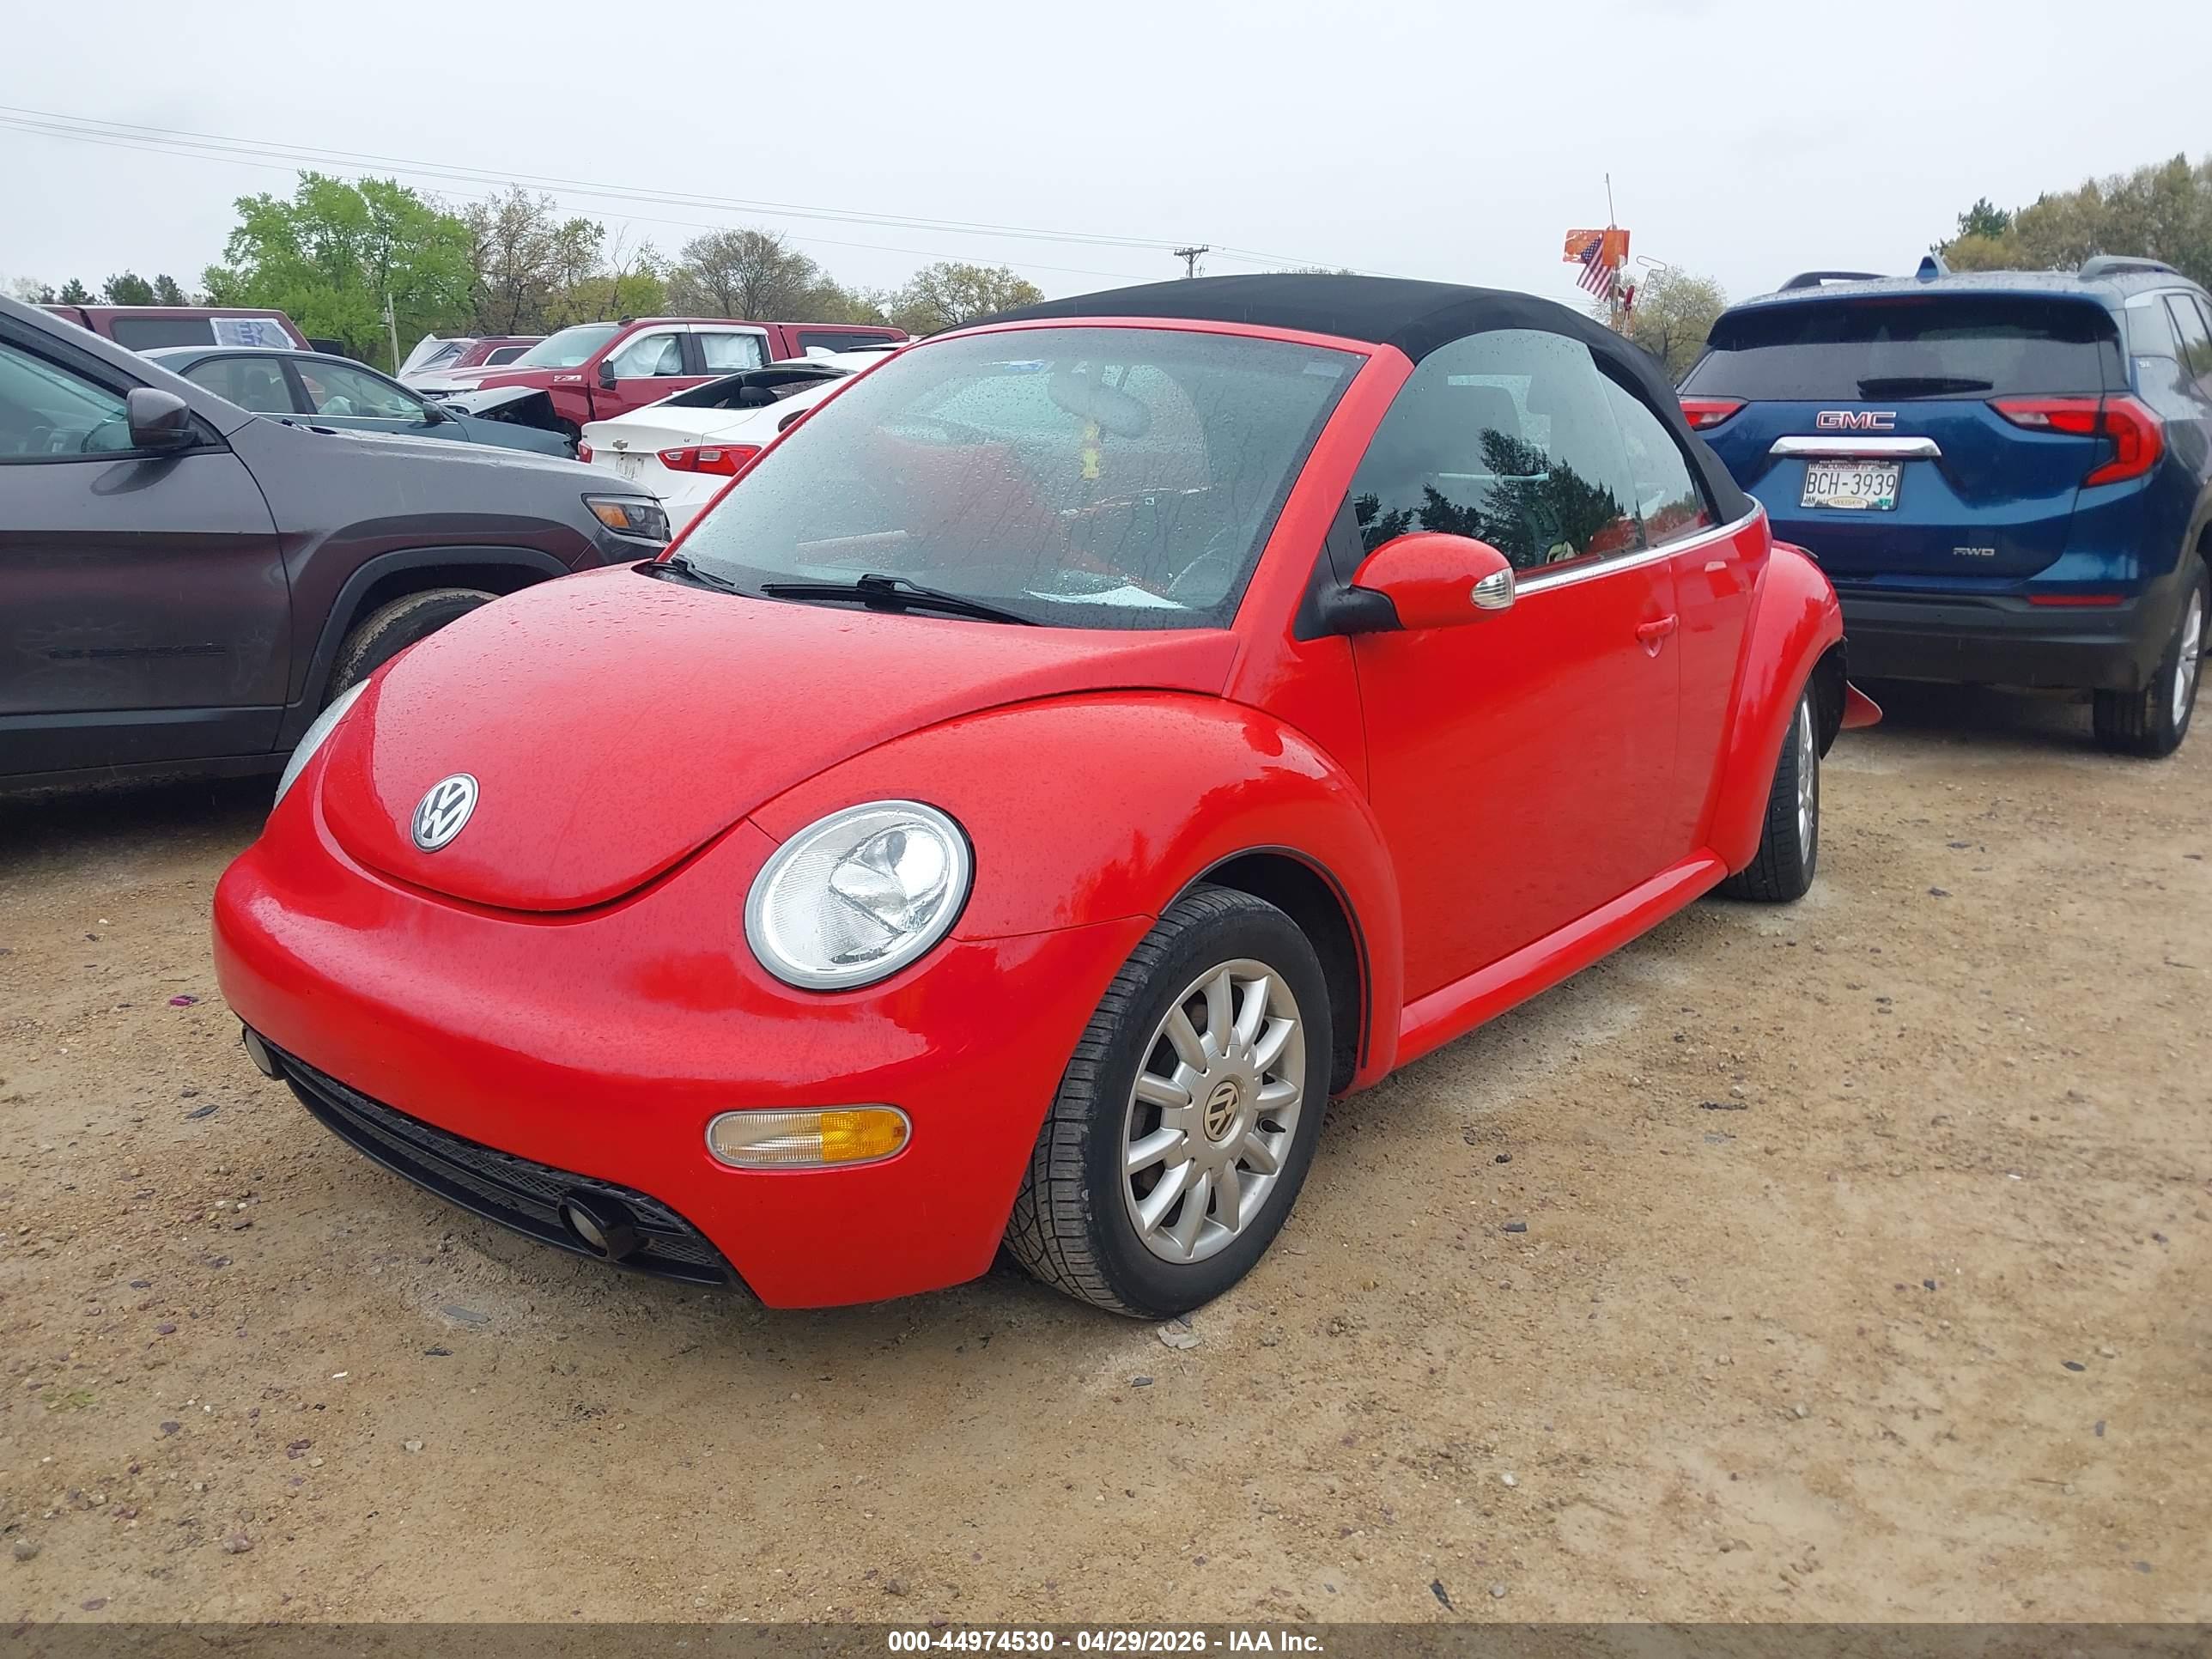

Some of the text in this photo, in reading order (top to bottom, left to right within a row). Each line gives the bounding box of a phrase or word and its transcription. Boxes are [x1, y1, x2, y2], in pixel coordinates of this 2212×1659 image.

[1816, 411, 1896, 429] GMC
[1805, 471, 1896, 495] BCH-3939
[1954, 547, 1995, 556] AWD
